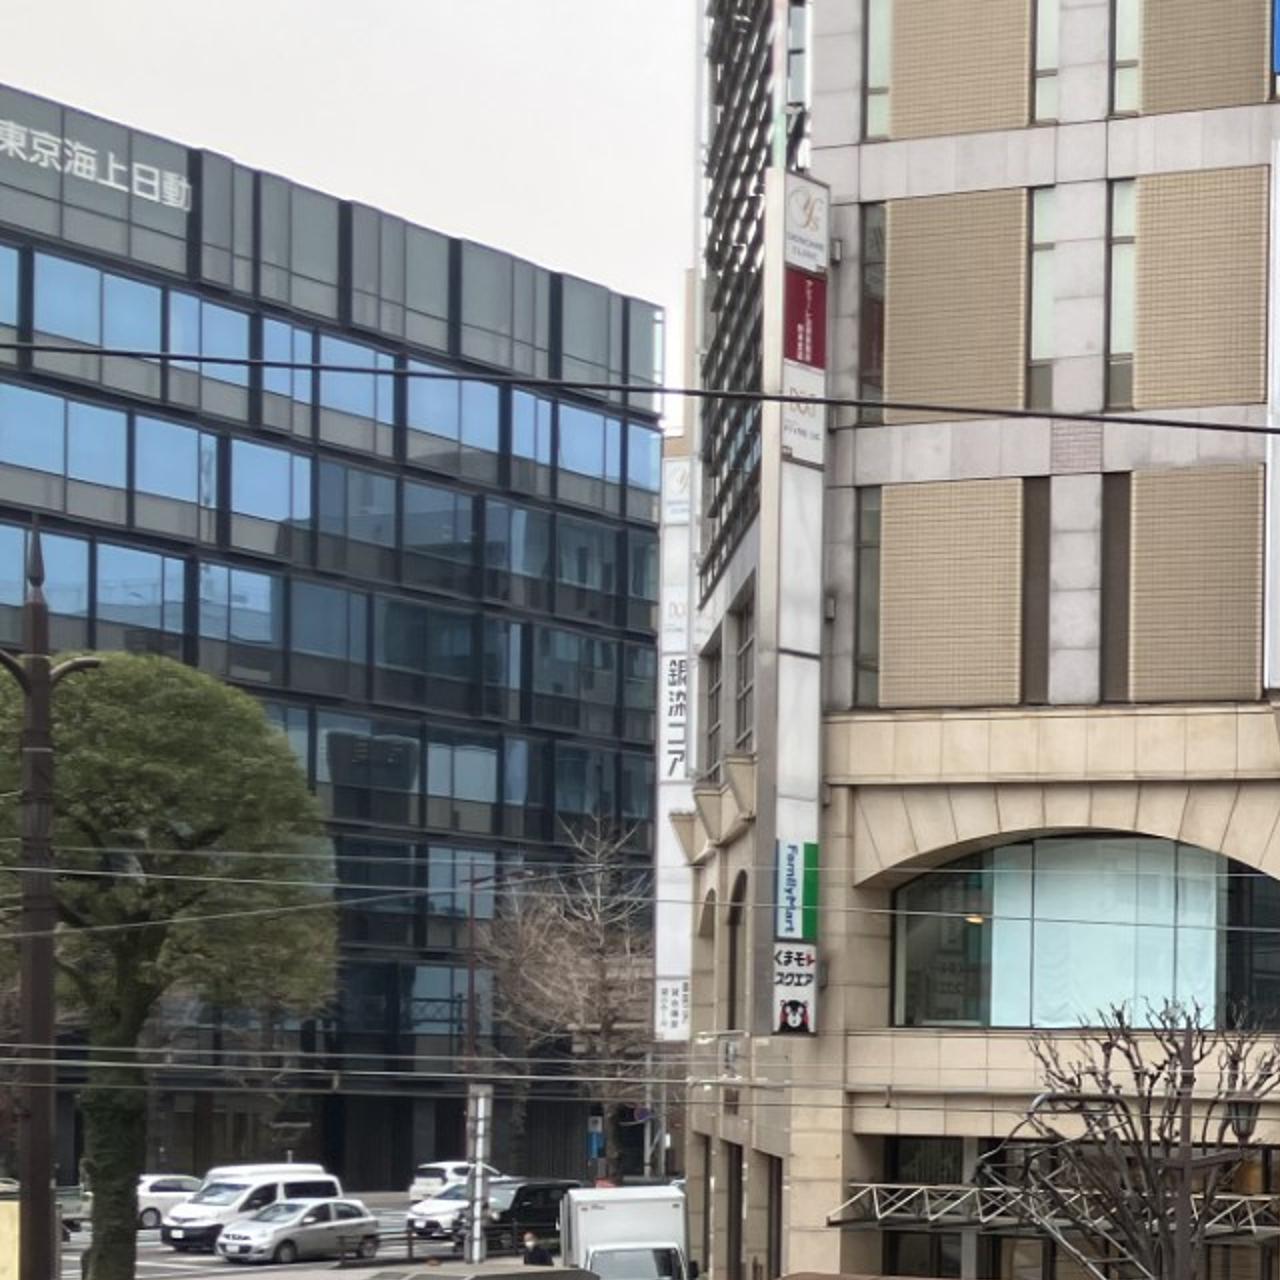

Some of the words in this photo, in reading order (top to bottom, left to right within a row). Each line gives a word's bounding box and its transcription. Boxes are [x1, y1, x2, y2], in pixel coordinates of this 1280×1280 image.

[0, 119, 192, 212] 東京海上日動
[784, 844, 799, 933] FamilyMart
[775, 971, 814, 987] スクエア
